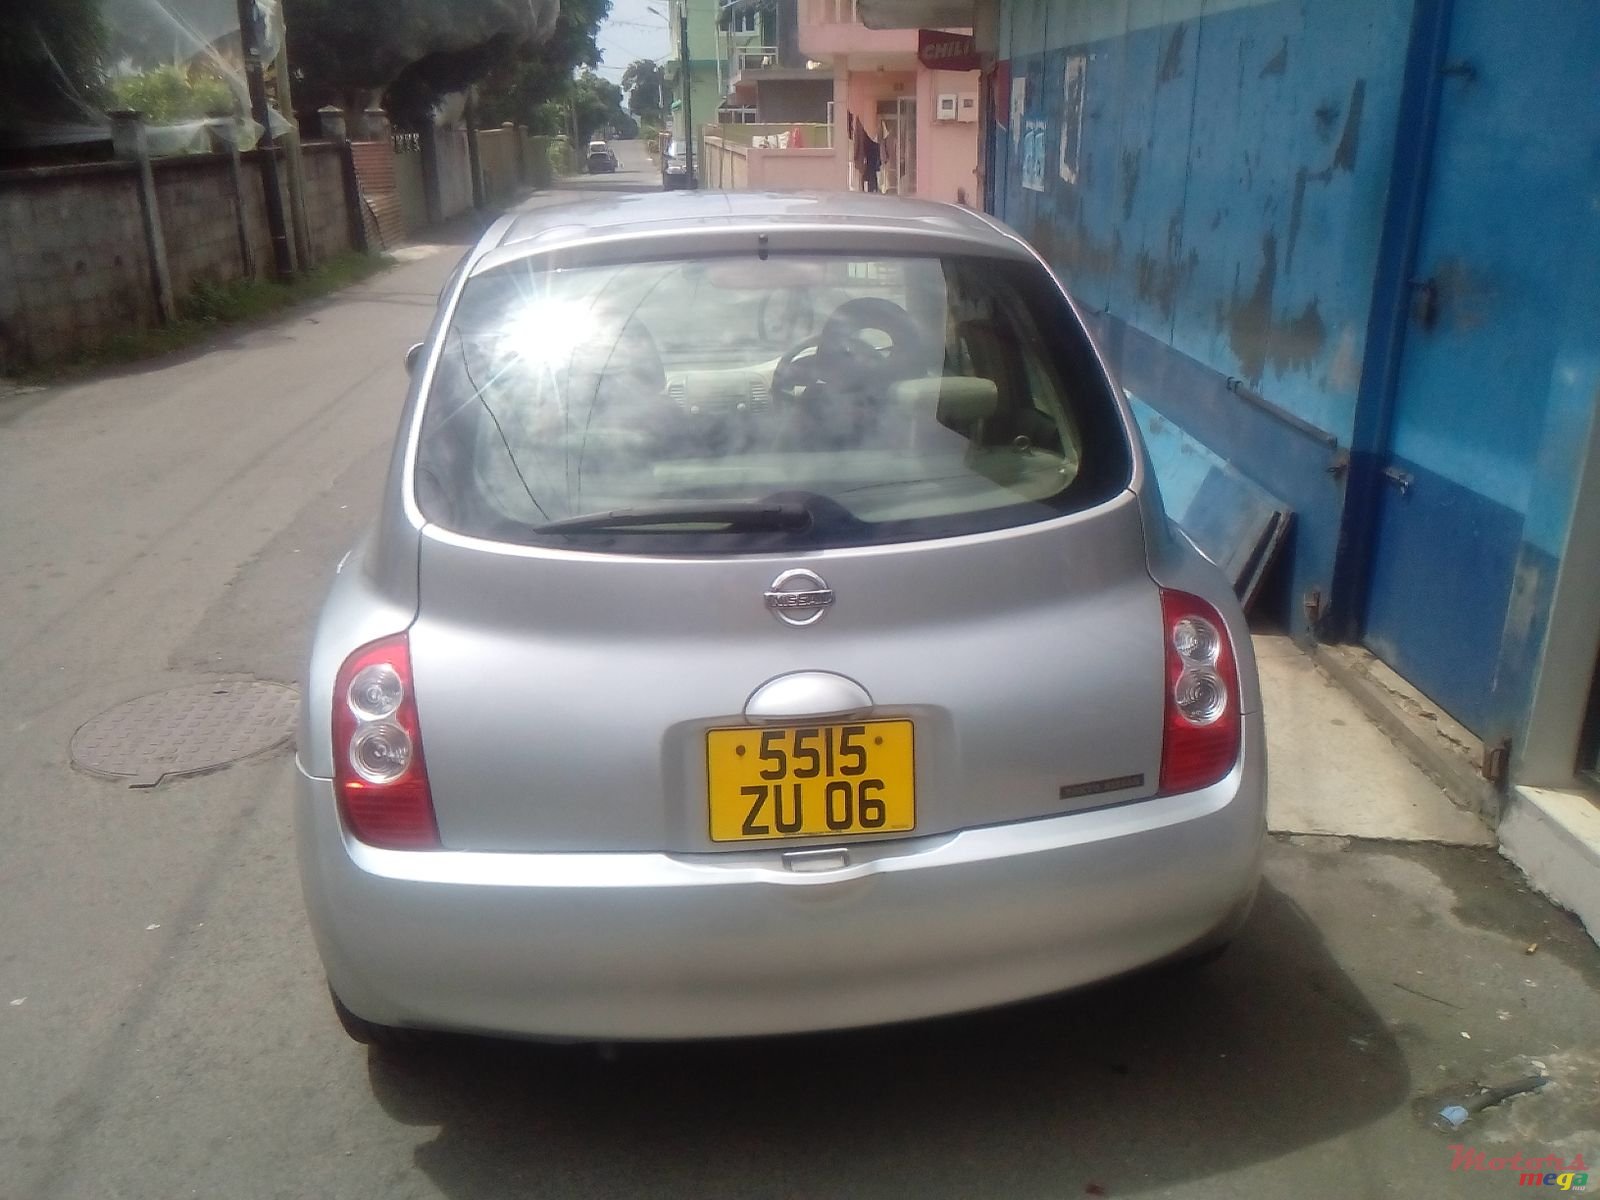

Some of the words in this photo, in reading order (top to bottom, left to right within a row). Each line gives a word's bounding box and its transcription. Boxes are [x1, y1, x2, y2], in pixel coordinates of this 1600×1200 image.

[760, 727, 866, 780] 5515
[741, 783, 803, 835] ZU
[825, 779, 886, 830] 06
